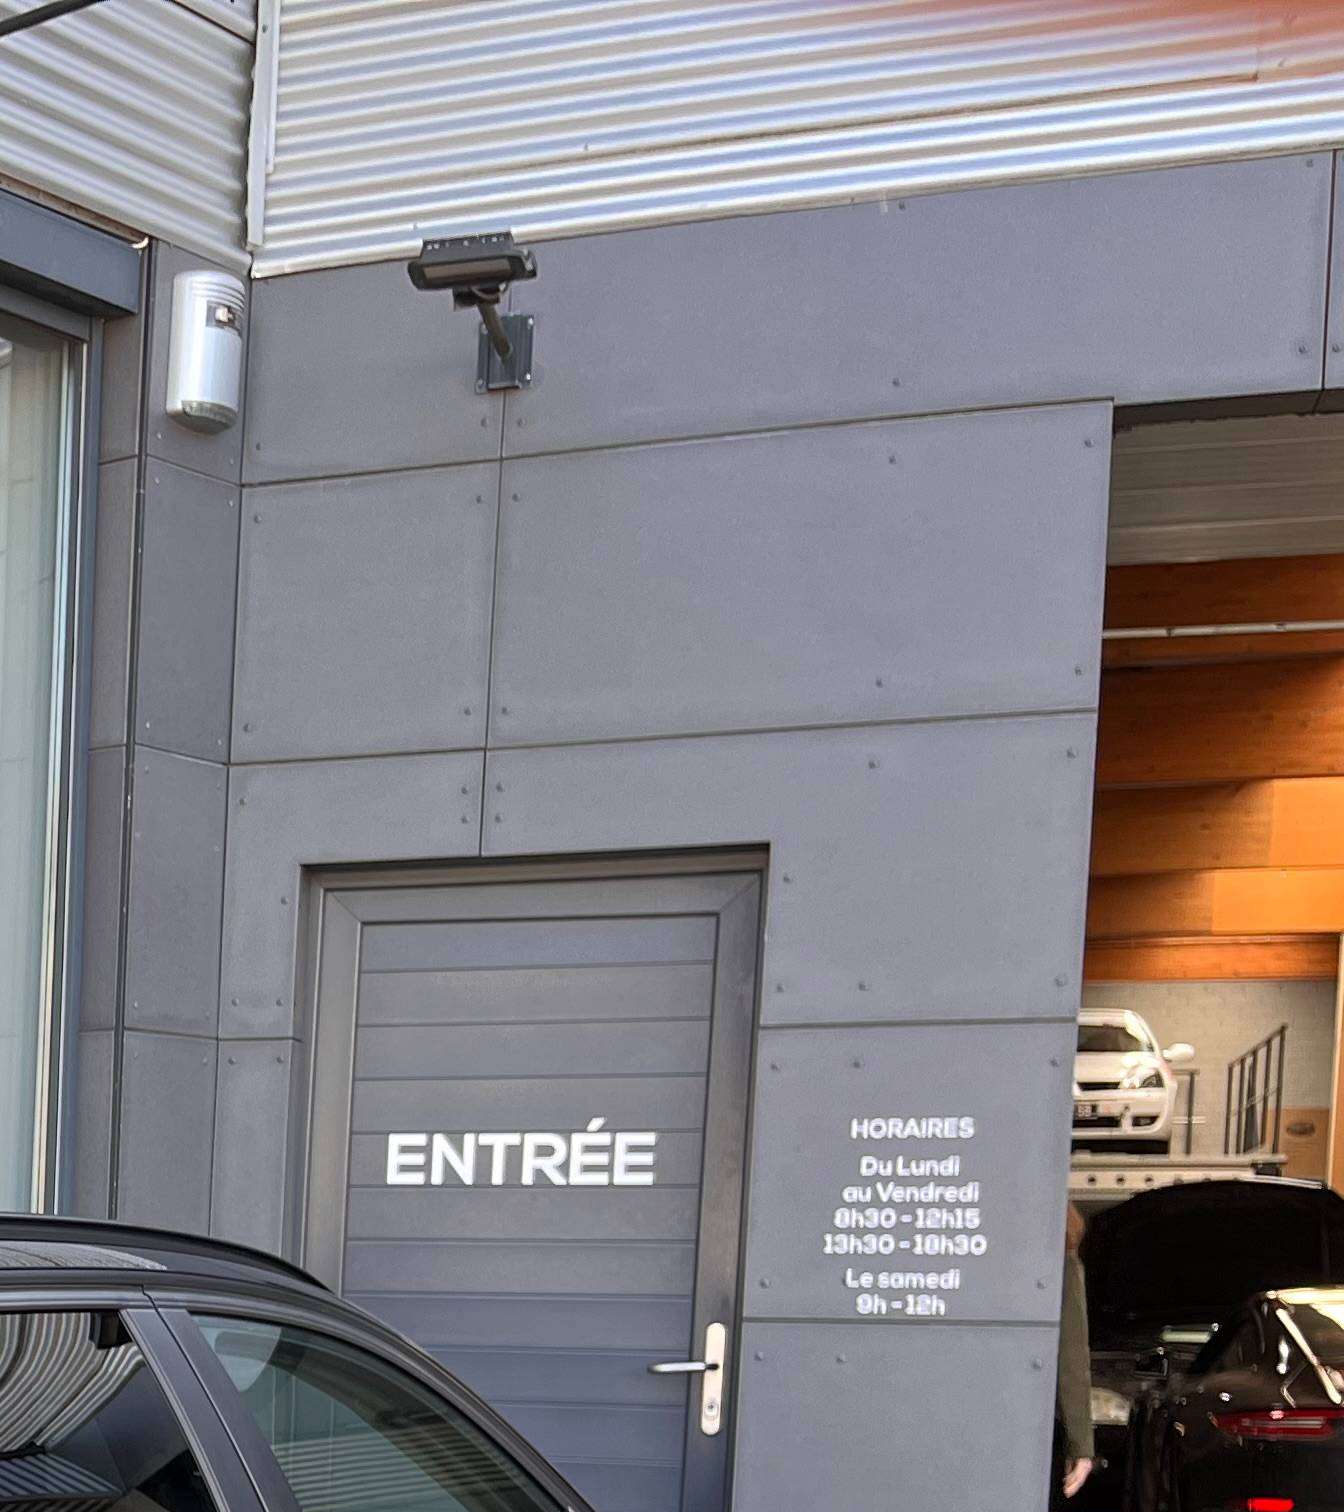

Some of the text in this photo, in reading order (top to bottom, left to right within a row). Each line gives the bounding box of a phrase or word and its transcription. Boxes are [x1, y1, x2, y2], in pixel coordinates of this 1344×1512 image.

[851, 1116, 975, 1139] HORAIRES
[386, 1117, 657, 1186] ENTRÉE
[860, 1155, 961, 1177] Du Lundi
[842, 1181, 980, 1203] au Vendredi
[834, 1207, 897, 1229] 8h30
[915, 1207, 981, 1229] 12h15
[823, 1233, 895, 1255] 13h30
[846, 1268, 961, 1290] Le samedi
[856, 1293, 887, 1315] 9h
[905, 1294, 946, 1316] 12h
